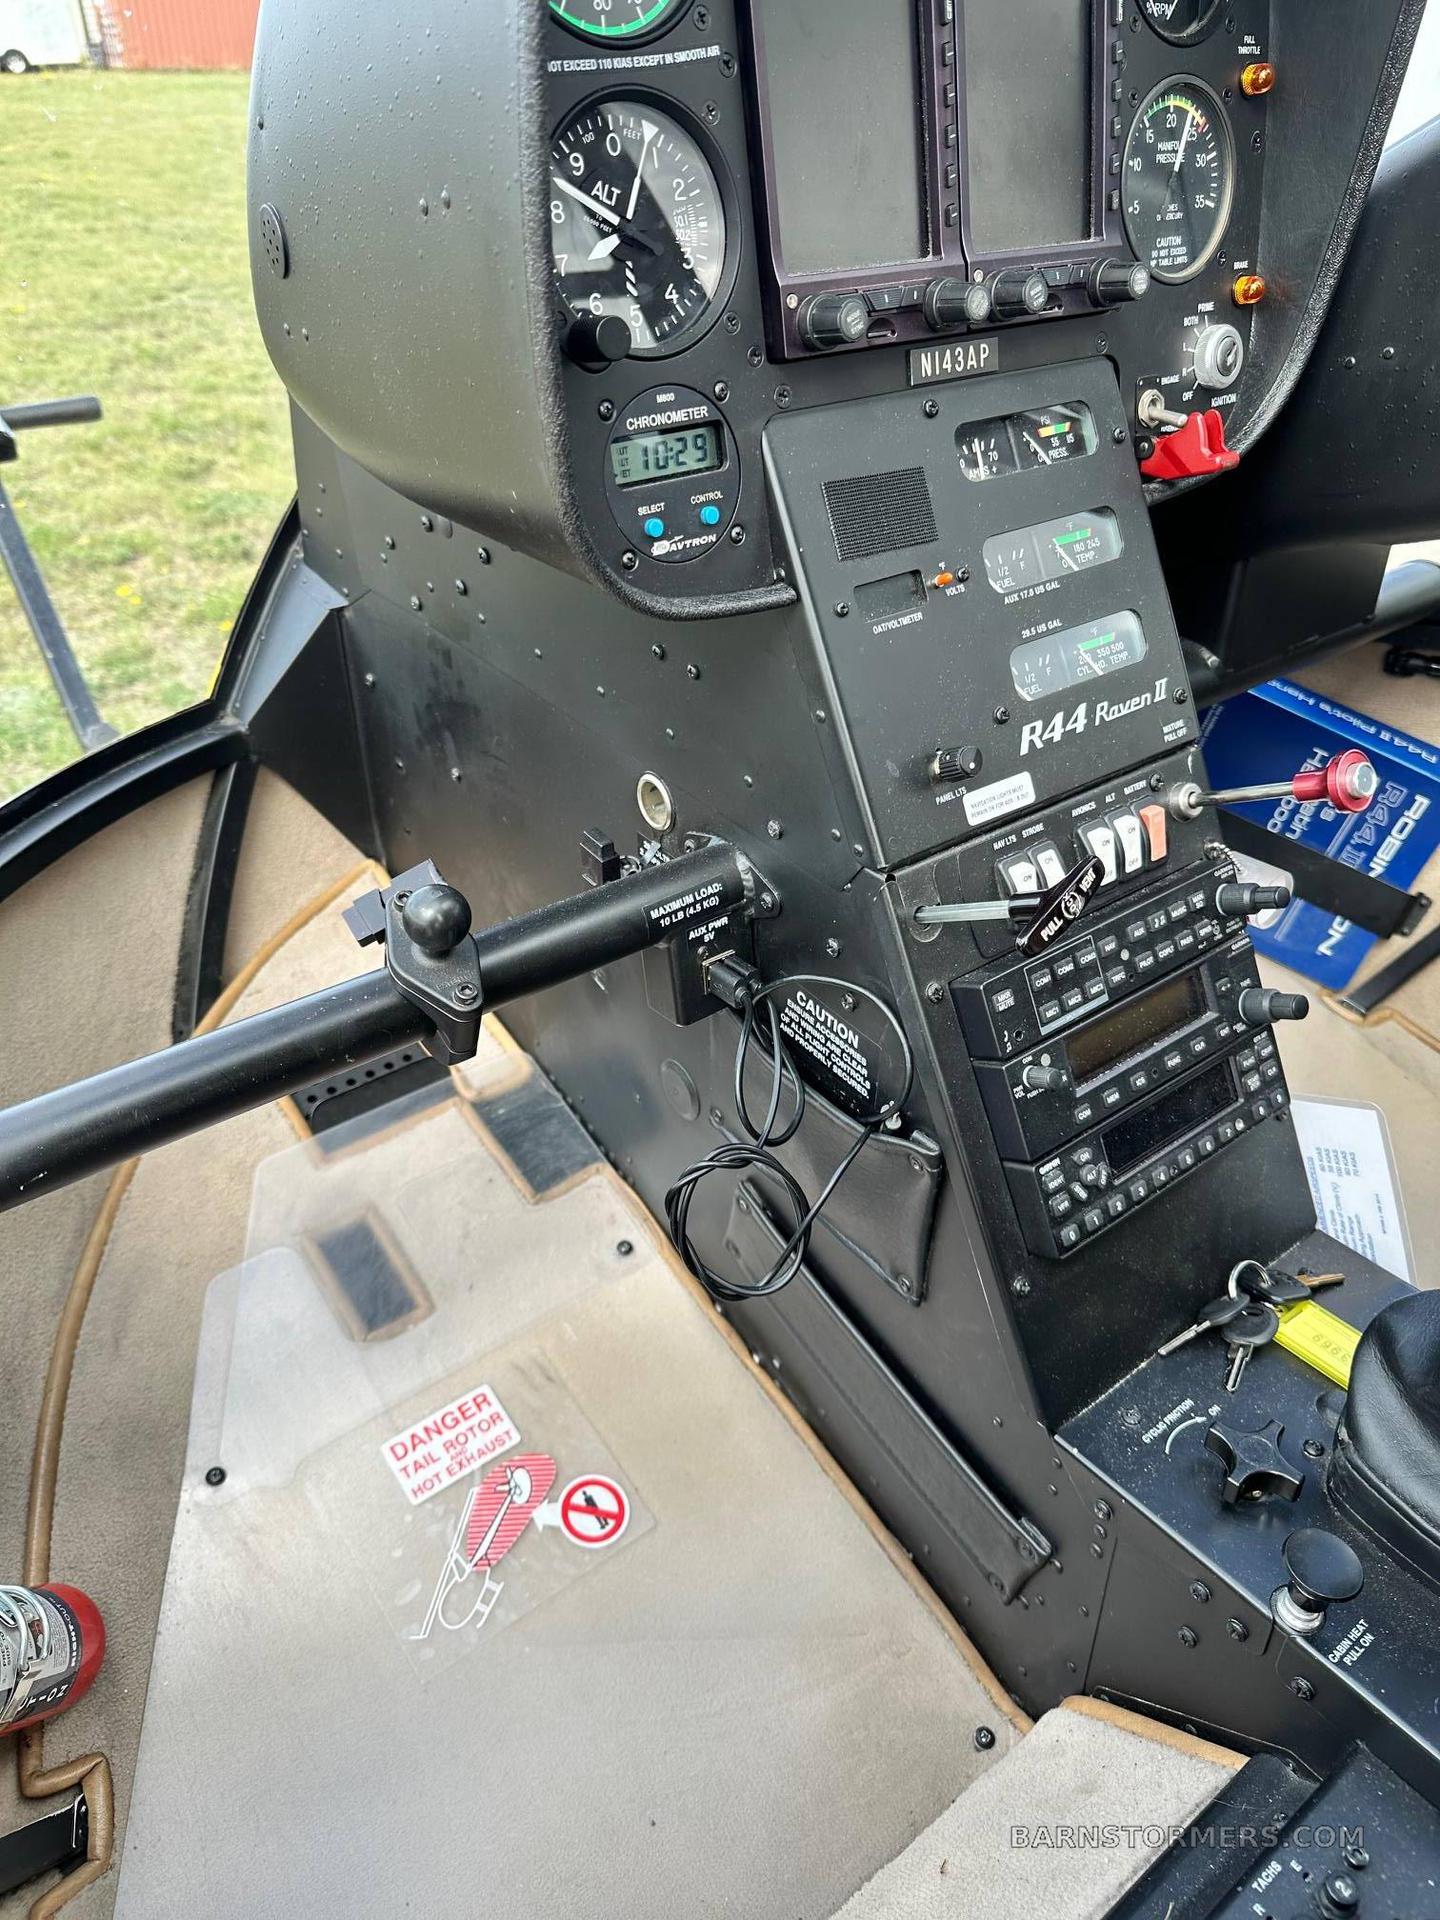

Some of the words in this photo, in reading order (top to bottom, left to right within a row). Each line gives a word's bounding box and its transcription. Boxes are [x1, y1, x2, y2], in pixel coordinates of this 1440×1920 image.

[1243, 35, 1255, 44] FULL
[547, 60, 562, 72] OT
[563, 59, 597, 71] EXCEED
[598, 59, 612, 70] 110
[612, 57, 633, 69] KIAS
[633, 54, 664, 67] EXCEPT
[665, 52, 674, 65] IN
[674, 47, 706, 63] SMOOTH
[707, 45, 720, 57] AIR
[1238, 46, 1261, 55] THROTTLE
[1166, 114, 1177, 128] 20
[582, 131, 595, 144] 100
[623, 128, 641, 140] FEET
[1146, 130, 1154, 144] 15
[1187, 128, 1197, 141] 25
[606, 133, 621, 156] 0
[569, 153, 585, 176] 9
[1133, 158, 1141, 172] 10
[1195, 154, 1207, 168] 30
[591, 180, 621, 206] ALT
[673, 178, 687, 201] 2
[1134, 201, 1140, 214] 5
[1195, 195, 1205, 209] 35
[550, 200, 565, 223] 8
[1156, 236, 1182, 248] CAUTION
[554, 254, 568, 277] 7
[681, 248, 694, 269] 3
[665, 283, 679, 304] 4
[589, 292, 603, 315] 6
[629, 305, 642, 327] 5
[1184, 315, 1199, 327] BOTH
[921, 343, 990, 378] N143AP
[1182, 391, 1194, 401] OFF
[1211, 393, 1237, 407] IGNITION
[626, 406, 708, 430] CHRONOMETER
[640, 433, 707, 471] 10:29
[988, 452, 999, 462] 70
[690, 490, 724, 505] CONTROL
[637, 502, 665, 516] SELECT
[650, 534, 717, 556] DAVTRON
[1073, 543, 1084, 553] 180
[1087, 537, 1100, 548] 245
[998, 566, 1009, 577] 1/2
[945, 583, 966, 597] VOLTS
[996, 578, 1015, 589] FUEL
[1004, 593, 1019, 605] AUX
[1035, 585, 1045, 595] US
[1046, 580, 1060, 591] GAL
[872, 611, 924, 635] OAT/VOLTMETER
[1021, 626, 1037, 639] 29.5
[1037, 623, 1047, 633] US
[1047, 618, 1063, 630] GAL
[1096, 646, 1110, 658] 350
[1111, 641, 1125, 653] 500
[1024, 673, 1036, 683] 1/2
[1023, 684, 1043, 695] FUEL
[1019, 702, 1088, 757] R44
[1094, 692, 1153, 727] Raven
[1153, 677, 1169, 703] II
[1319, 702, 1377, 735] Pilot's
[1394, 734, 1438, 763] R44
[935, 793, 955, 805] PANEL
[955, 786, 967, 797] LTS
[1123, 780, 1147, 795] BATTERY
[1105, 792, 1116, 804] ALT
[1071, 802, 1096, 818] AVIONICS
[1021, 822, 1045, 838] STROBE
[1127, 826, 1136, 835] ON
[993, 840, 1005, 851] NAV
[1005, 834, 1017, 845] LTS
[1101, 838, 1111, 847] ON
[1044, 856, 1054, 865] ON
[1023, 873, 1033, 883] ON
[1079, 867, 1096, 892] VENT
[650, 894, 695, 920] MAXIMUM
[695, 883, 723, 901] LOAD:
[659, 917, 671, 928] 10
[672, 911, 685, 923] LB
[686, 904, 702, 918] (4.5
[702, 896, 720, 909] KG)
[1171, 905, 1187, 918] MUSIC
[688, 926, 707, 940] AUX
[708, 916, 729, 931] PWR
[1040, 916, 1063, 942] PULL
[1133, 927, 1145, 937] AUX
[703, 931, 715, 943] 5V
[1058, 963, 1074, 975] COM2
[1035, 975, 1052, 987] COM1
[998, 1001, 1015, 1012] MUTE
[1045, 1007, 1060, 1018] MIC1
[796, 991, 859, 1048] CAUTION
[786, 998, 815, 1026] ENSURE
[816, 1021, 867, 1067] ACCESSORIES
[784, 1007, 799, 1022] AND
[800, 1018, 826, 1044] WIRING
[826, 1040, 842, 1056] ARE
[842, 1053, 868, 1078] CLEAR
[780, 1013, 791, 1024] OF
[791, 1022, 804, 1037] ALL
[805, 1032, 830, 1058] FLIGHT
[830, 1052, 871, 1090] CONTROLS
[780, 1022, 795, 1038] AND
[795, 1033, 832, 1068] PROPERLY
[832, 1065, 870, 1099] SECURED.
[1078, 1108, 1092, 1120] COM
[1080, 1151, 1090, 1162] ON
[1048, 1174, 1066, 1190] IDENT
[1086, 1169, 1097, 1182] ALT
[1069, 1230, 1076, 1241] 0
[1093, 1216, 1100, 1226] 1
[1115, 1200, 1122, 1211] 2
[1138, 1186, 1145, 1197] 3
[1158, 1171, 1166, 1181] 4
[1225, 1128, 1232, 1137] 7
[1208, 1404, 1222, 1417] ON
[389, 1391, 494, 1463] DANGER
[1141, 1421, 1167, 1444] CYCLIC
[1163, 1398, 1195, 1425] FRICTION
[400, 1452, 441, 1481] TAIL
[442, 1411, 505, 1454] ROTOR
[411, 1476, 444, 1500] HOT
[445, 1430, 515, 1475] EXHAUST
[1328, 1636, 1353, 1664] CABIN
[1348, 1618, 1370, 1644] HEAT
[1342, 1643, 1365, 1666] PULL
[1360, 1632, 1375, 1649] ON
[1289, 1859, 1303, 1872] E
[1251, 1860, 1282, 1893] TACHS
[1335, 1880, 1352, 1898] 2
[1252, 1903, 1266, 1917] R
